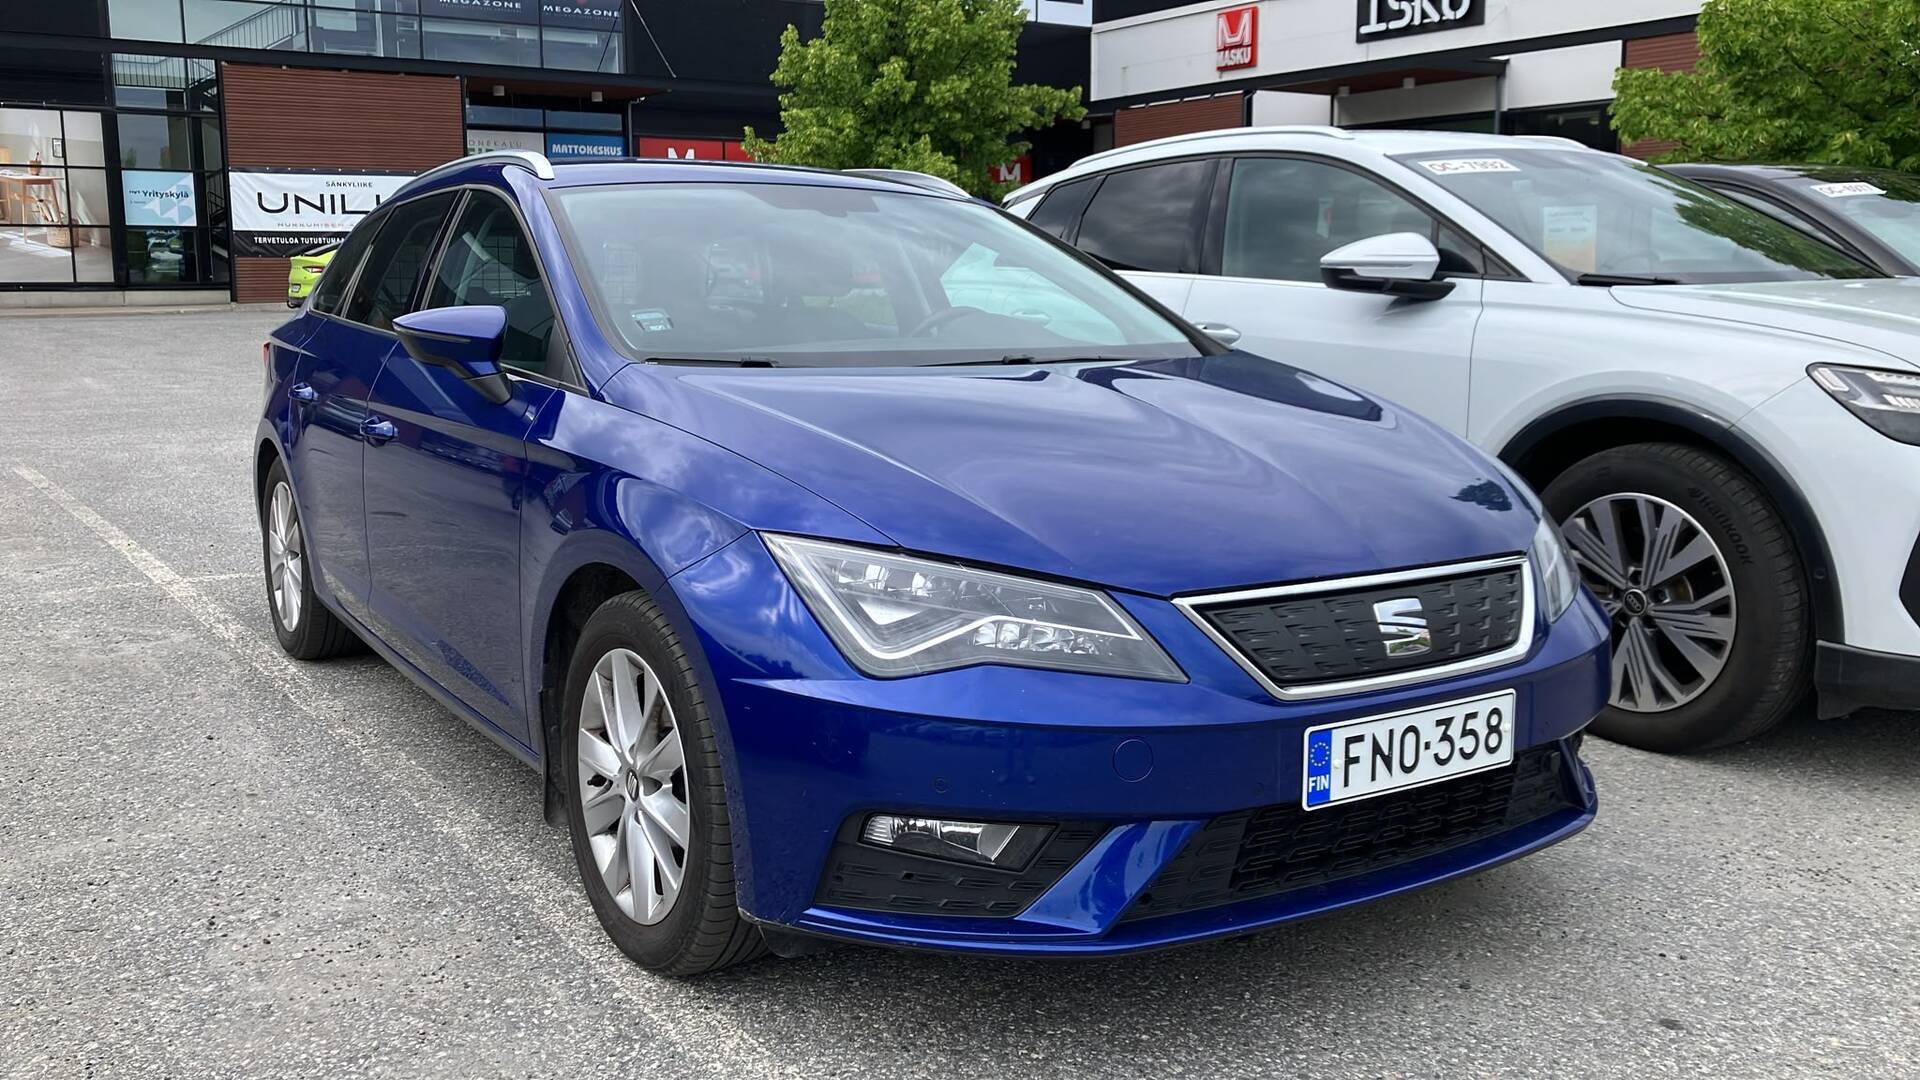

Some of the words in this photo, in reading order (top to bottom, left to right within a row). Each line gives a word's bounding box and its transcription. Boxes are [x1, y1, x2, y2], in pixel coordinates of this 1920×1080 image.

[543, 5, 620, 18] MEGAZONE
[1217, 46, 1252, 67] MASKU
[552, 143, 622, 156] MATTOKESKUS
[325, 180, 373, 188] SÄNKYLIIKE
[142, 188, 190, 200] Yrityskylä
[253, 236, 299, 244] TERVETULOA
[1308, 774, 1330, 792] FIN
[1343, 707, 1503, 788] FNO-358
